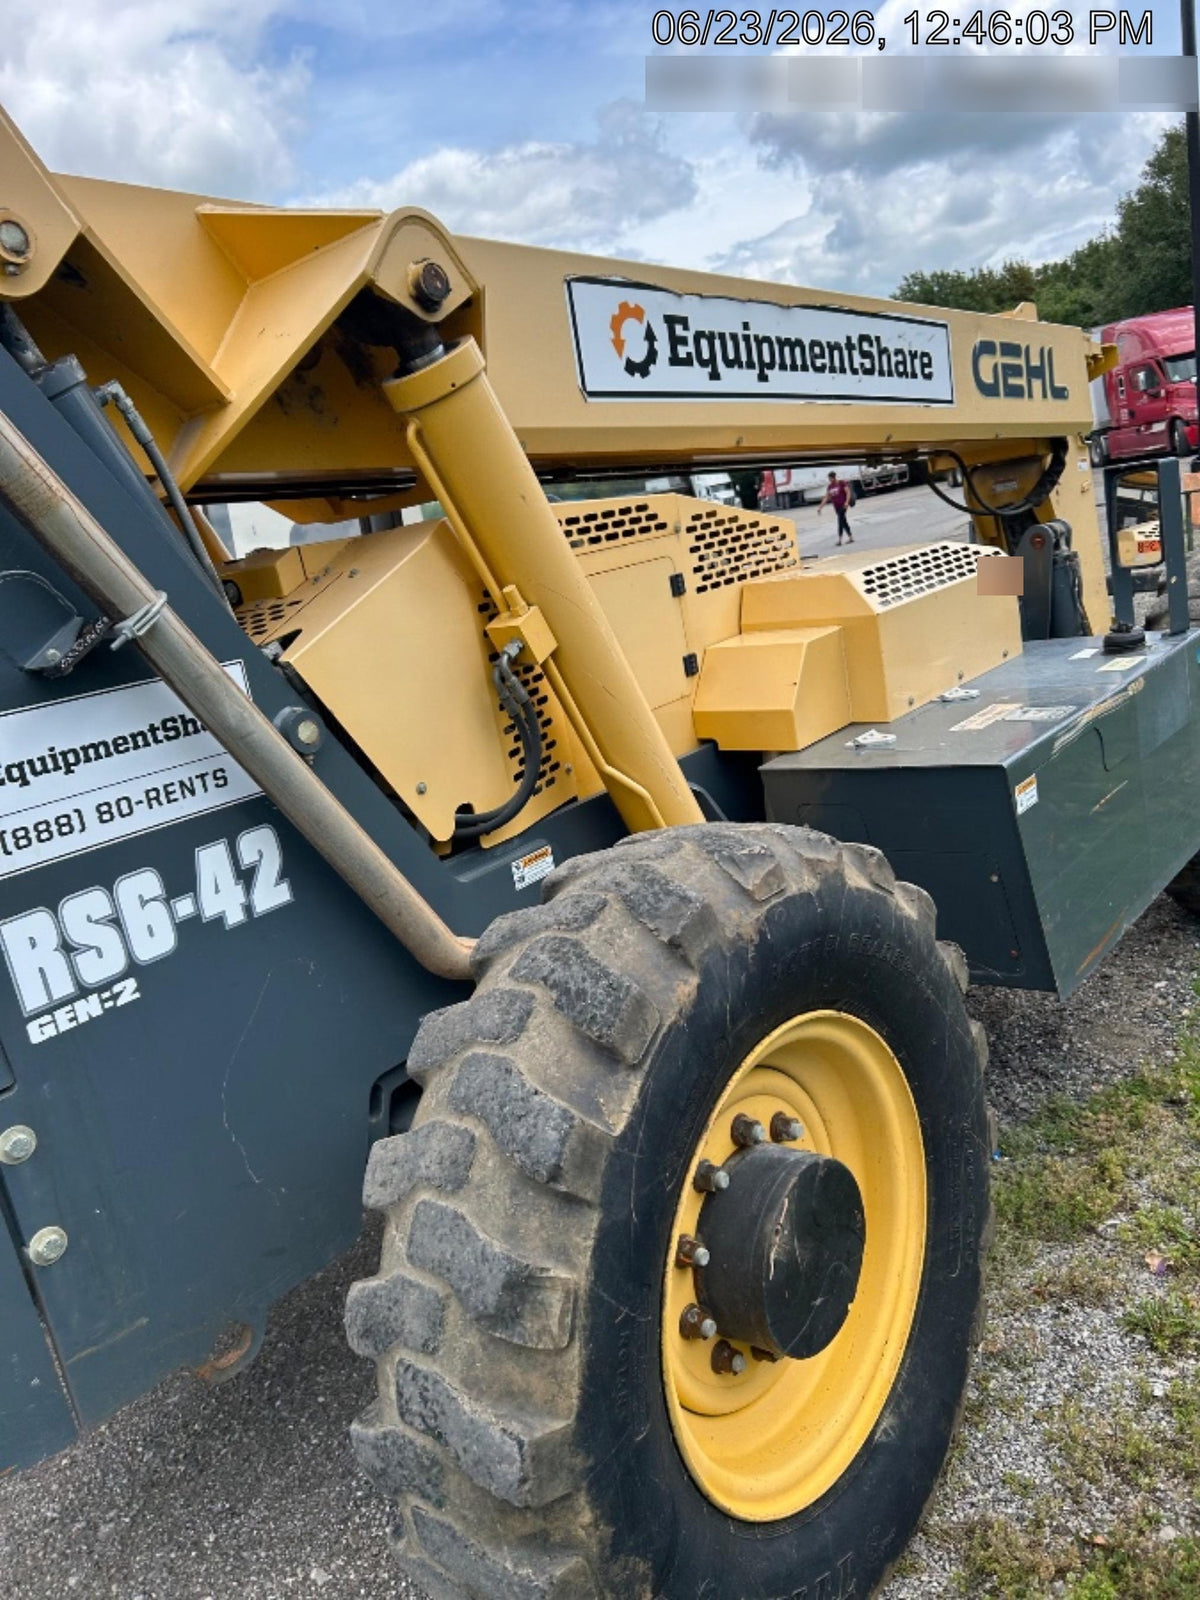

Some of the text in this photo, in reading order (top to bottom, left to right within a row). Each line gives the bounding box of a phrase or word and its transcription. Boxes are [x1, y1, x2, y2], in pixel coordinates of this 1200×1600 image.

[664, 314, 934, 383] EquipmentShare
[973, 340, 1068, 400] GEHL
[0, 714, 207, 788] quipmentSh
[1, 767, 229, 857] (888) 80-RENTS
[0, 824, 294, 1017] RS6-42
